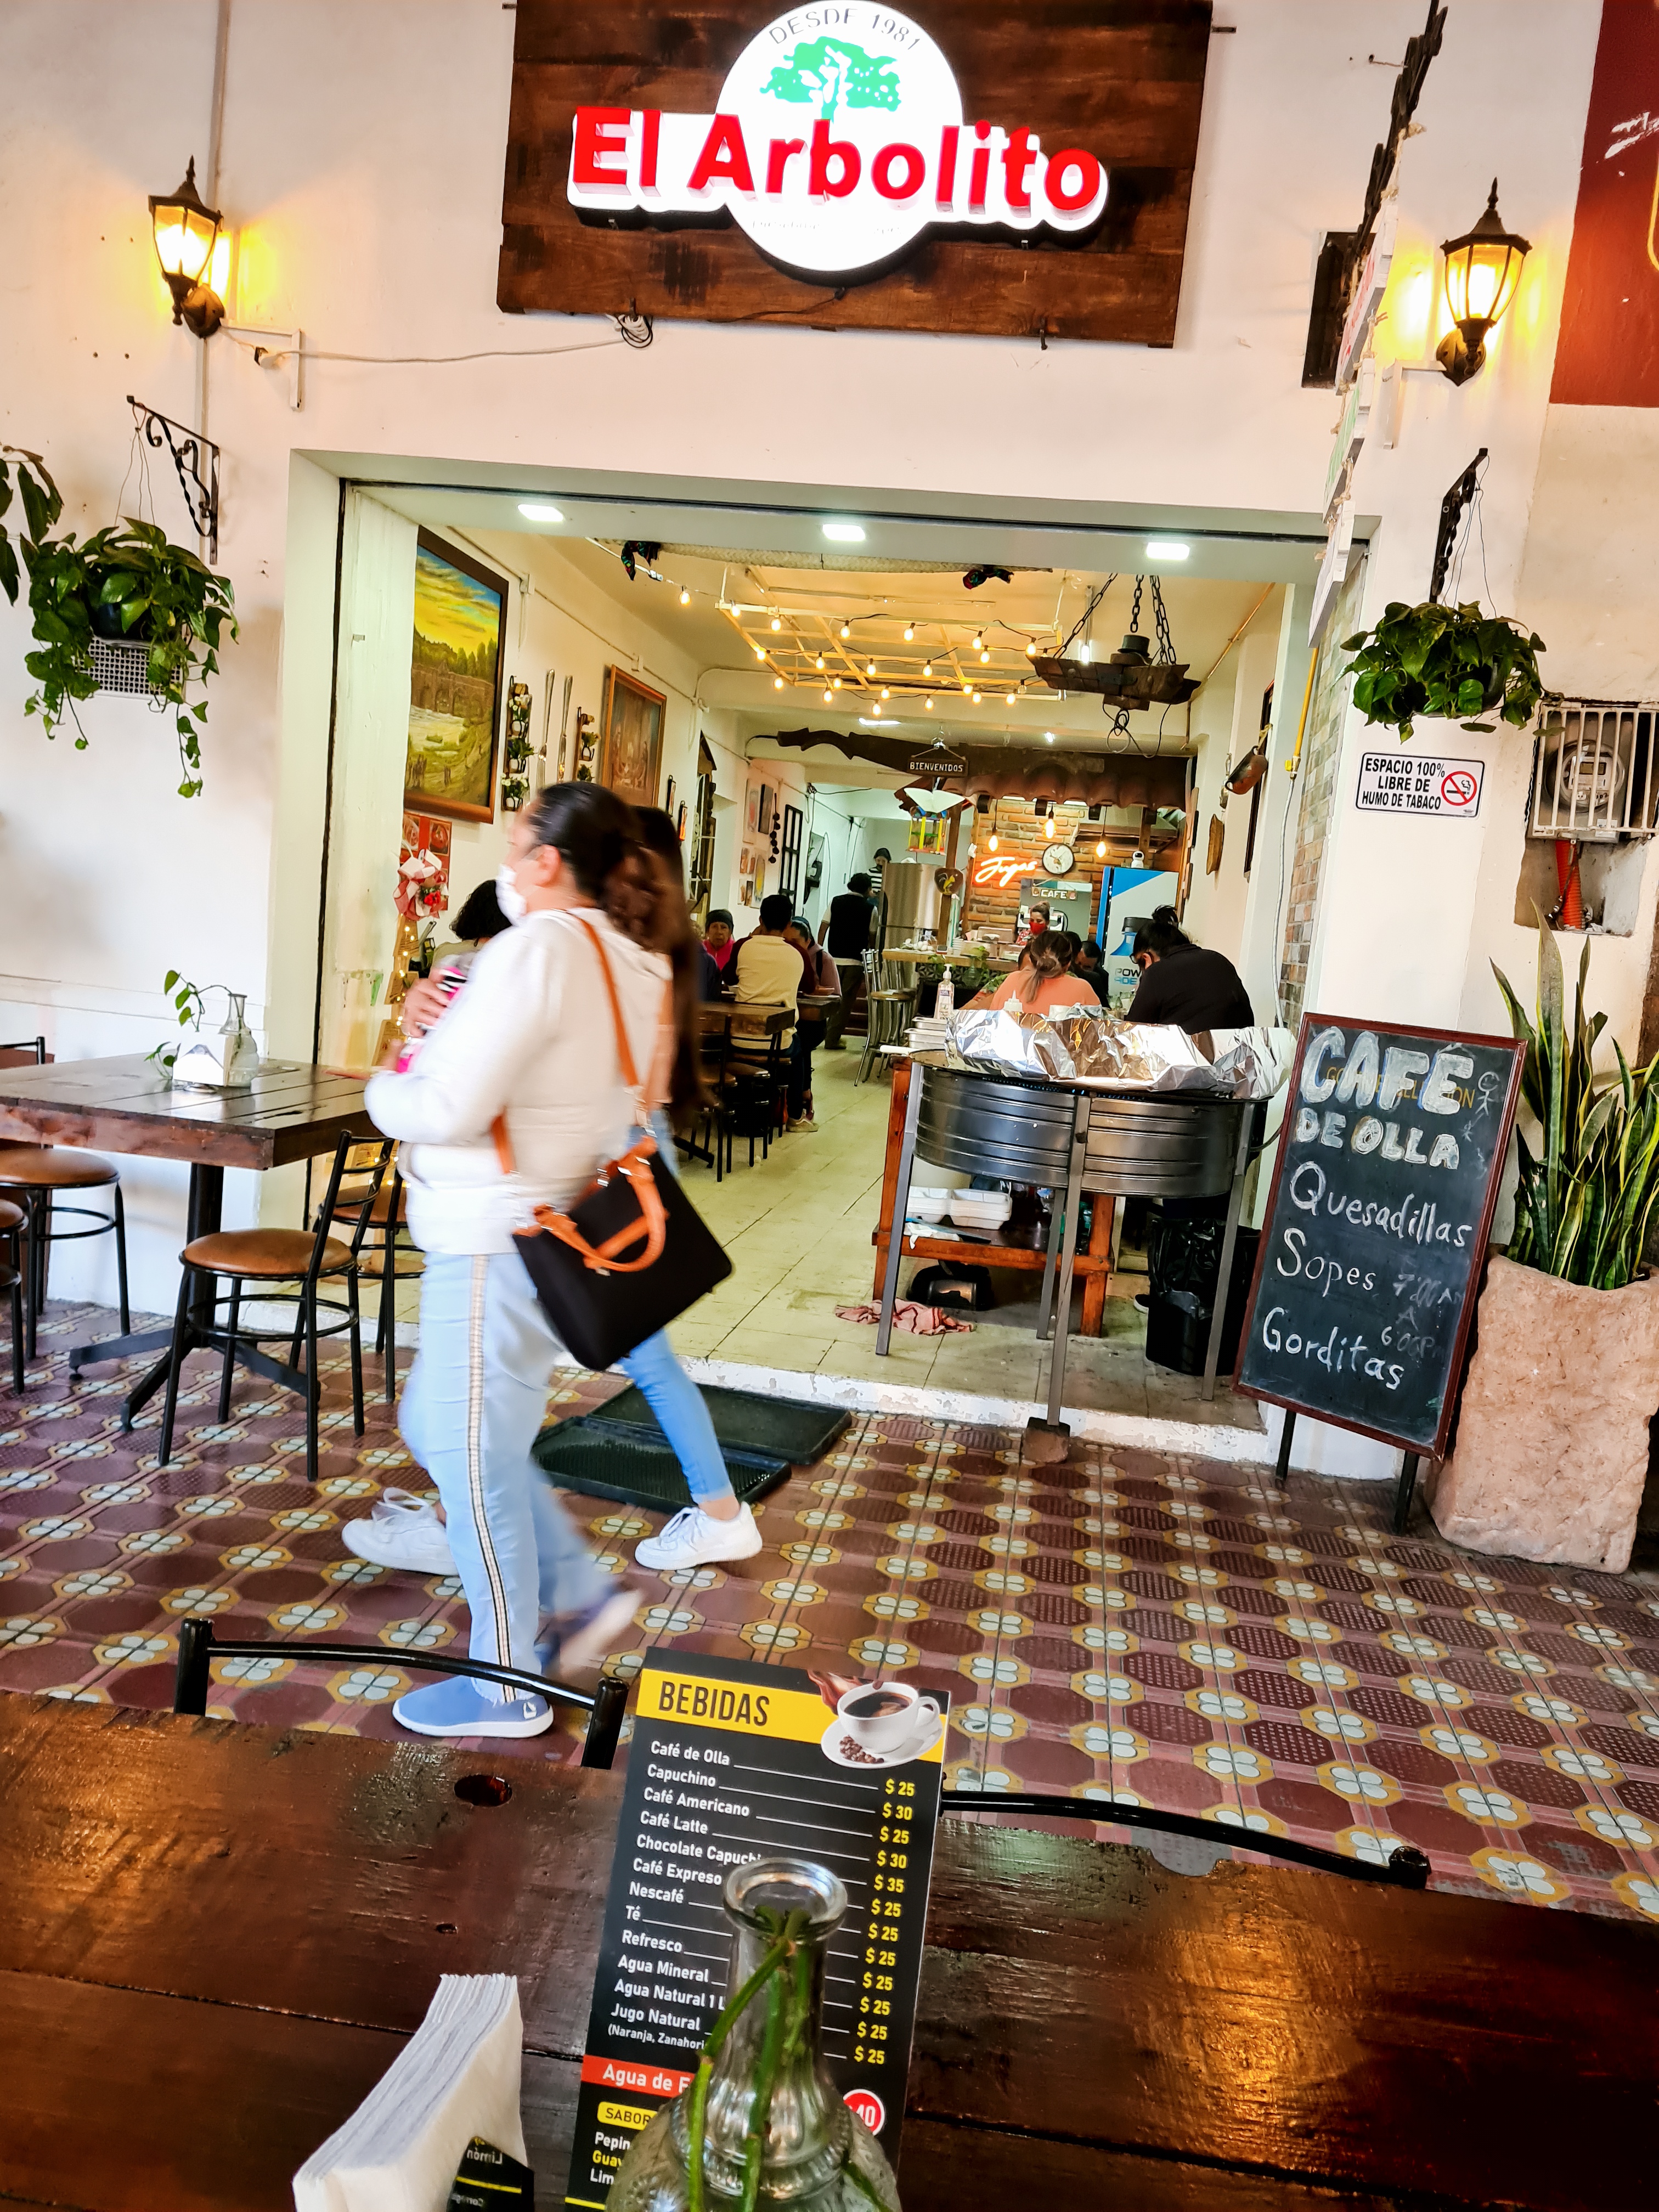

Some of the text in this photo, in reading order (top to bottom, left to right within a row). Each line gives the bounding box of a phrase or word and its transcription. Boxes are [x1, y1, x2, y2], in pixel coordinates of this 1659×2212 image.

[872, 14, 921, 50] 1981
[573, 106, 1101, 213] El Arbolito
[910, 761, 964, 772] BIENVENIDOS
[1365, 758, 1445, 778] ESPACIO 100%
[1378, 776, 1430, 792] LIBRE DE
[1362, 791, 1441, 810] HUMO DE TABACO
[1040, 889, 1068, 899] CAFE
[1115, 968, 1142, 977] POW
[1296, 1107, 1459, 1170] DE OLLA
[1290, 1161, 1472, 1247] Quesadillas
[1277, 1227, 1376, 1297] Sopes
[1263, 1307, 1404, 1390] Gorditas
[658, 1680, 770, 1726] BEBIDAS
[647, 1764, 716, 1787] Capuchino
[895, 1805, 912, 1820] 30
[651, 1740, 680, 1757] Café
[684, 1746, 700, 1760] de
[703, 1749, 730, 1765] Olla
[898, 1781, 915, 1797] 25
[640, 1810, 670, 1828] Café
[673, 1816, 708, 1834] Latte
[890, 1853, 907, 1869] 30
[644, 1787, 673, 1804] Café
[676, 1792, 750, 1816] Americano
[892, 1829, 909, 1844] 25
[633, 1858, 663, 1875] Café
[667, 1863, 722, 1885] Expreso
[884, 1901, 901, 1917] 25
[637, 1834, 703, 1858] Chocolate
[707, 1846, 761, 1865] Capuch
[887, 1877, 904, 1893] 35
[625, 1905, 641, 1921] Té
[878, 1951, 896, 1966] 25
[629, 1881, 684, 1904] Nescafé
[881, 1926, 899, 1942] 25
[617, 1954, 653, 1973] Agua
[657, 1960, 709, 1983] Mineral
[873, 2000, 890, 2016] 25
[622, 1929, 682, 1953] Refresco
[876, 1975, 893, 1991] 25
[608, 2023, 704, 2050] (Naranja, Zanahori
[611, 2003, 644, 2022] Jugo
[648, 2008, 701, 2030] Natural
[867, 2049, 885, 2064] 25
[614, 1978, 650, 1997] Agua
[653, 1984, 706, 2007] Natural
[709, 1994, 714, 2008] 1
[870, 2024, 888, 2040] 25
[603, 2063, 647, 2087] Agua
[652, 2073, 673, 2091] de
[595, 2131, 630, 2151] Pepin
[606, 2108, 651, 2124] SABOR
[590, 2168, 614, 2185] Lim
[592, 2150, 622, 2167] Gua
